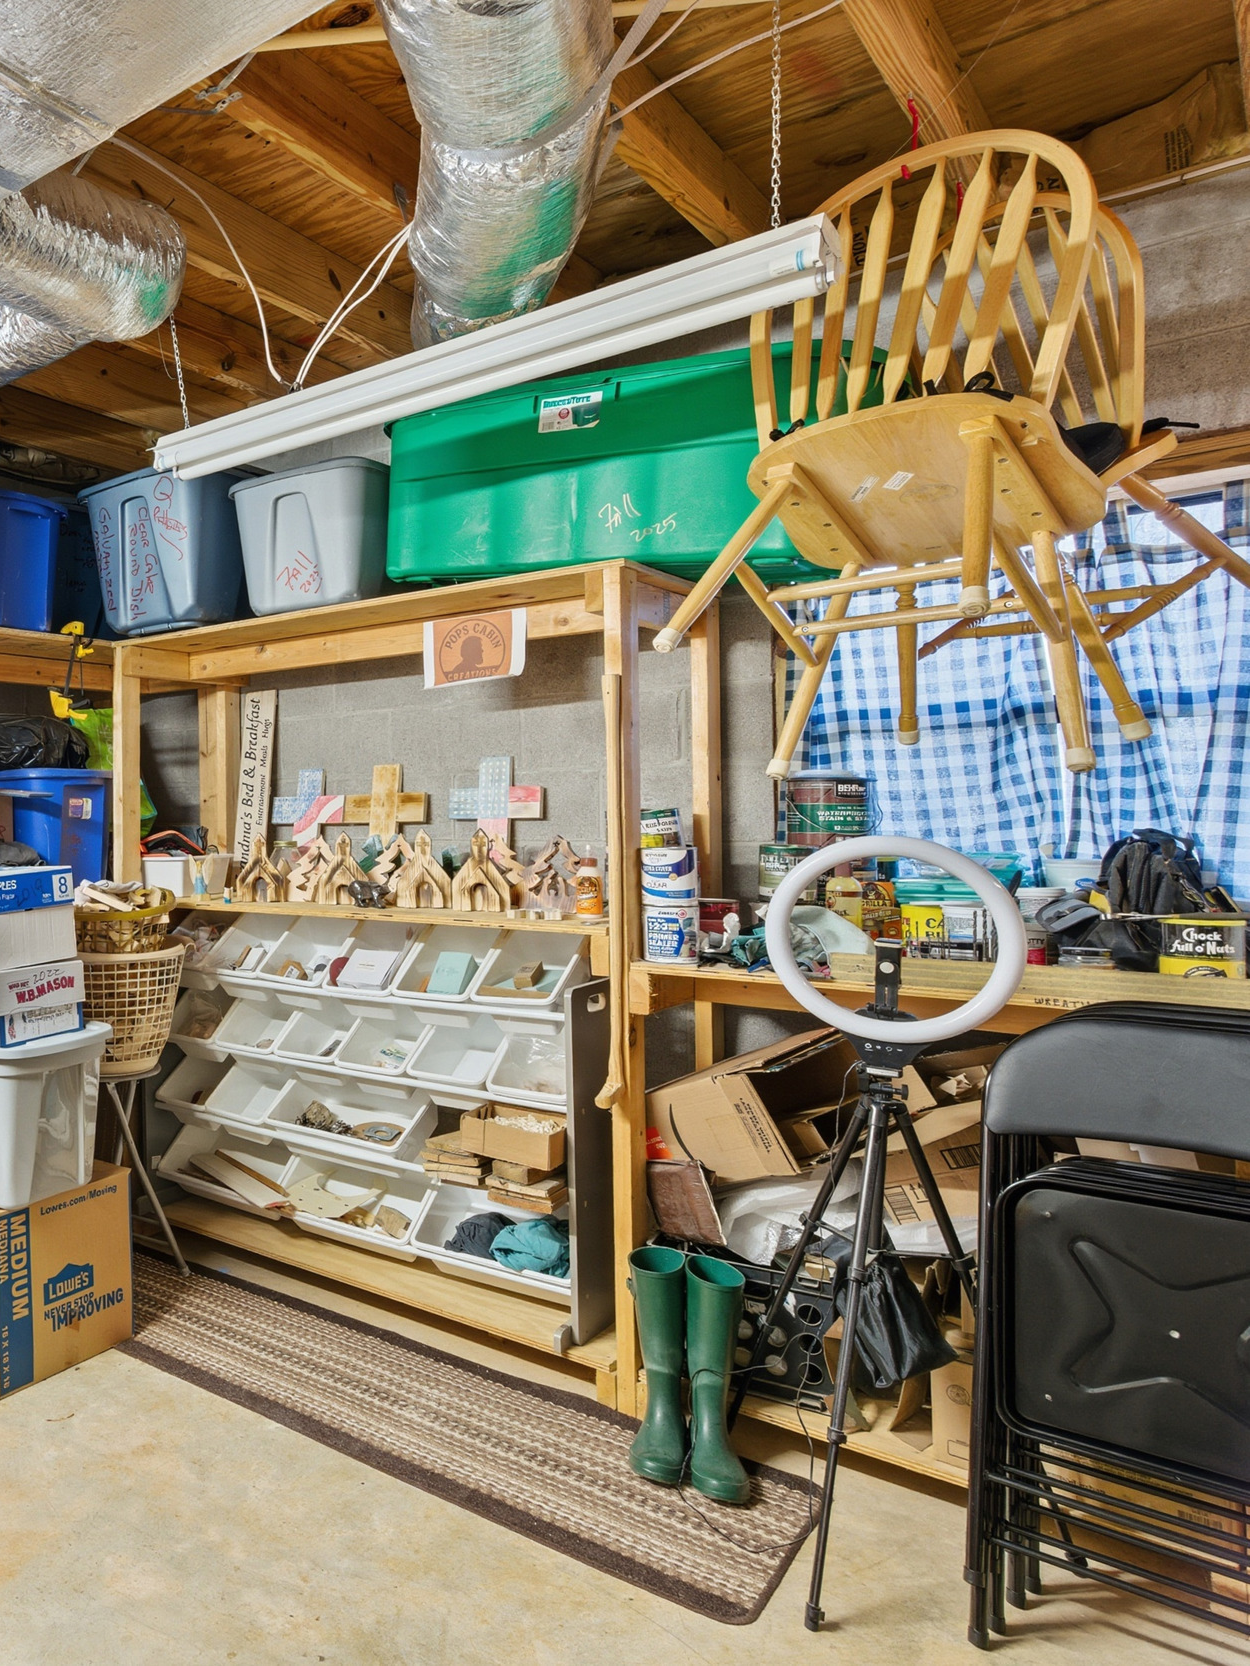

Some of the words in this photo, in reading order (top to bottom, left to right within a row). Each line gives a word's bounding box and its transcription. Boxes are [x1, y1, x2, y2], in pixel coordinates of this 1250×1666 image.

[630, 512, 678, 542] 2025
[445, 625, 469, 650] POPS
[473, 623, 502, 648] CABIN
[447, 668, 498, 682] CREATIONS
[244, 698, 263, 762] Breakfast
[262, 718, 273, 740] Hugs
[260, 744, 268, 769] Meals
[243, 764, 256, 780] &
[242, 782, 254, 808] Bed
[58, 876, 68, 895] 8
[926, 918, 944, 929] CA
[1182, 928, 1222, 942] Chock
[1170, 941, 1193, 953] full
[16, 976, 75, 1004] W.B.MASON
[33, 969, 65, 985] 2022
[40, 1184, 118, 1216] Lowes.com/Moving
[10, 1213, 29, 1321] MEDIUM
[49, 1271, 89, 1300] LOWE'S
[44, 1300, 73, 1321] NEVER
[73, 1291, 95, 1308] STOP
[52, 1288, 124, 1332] IMPROVING
